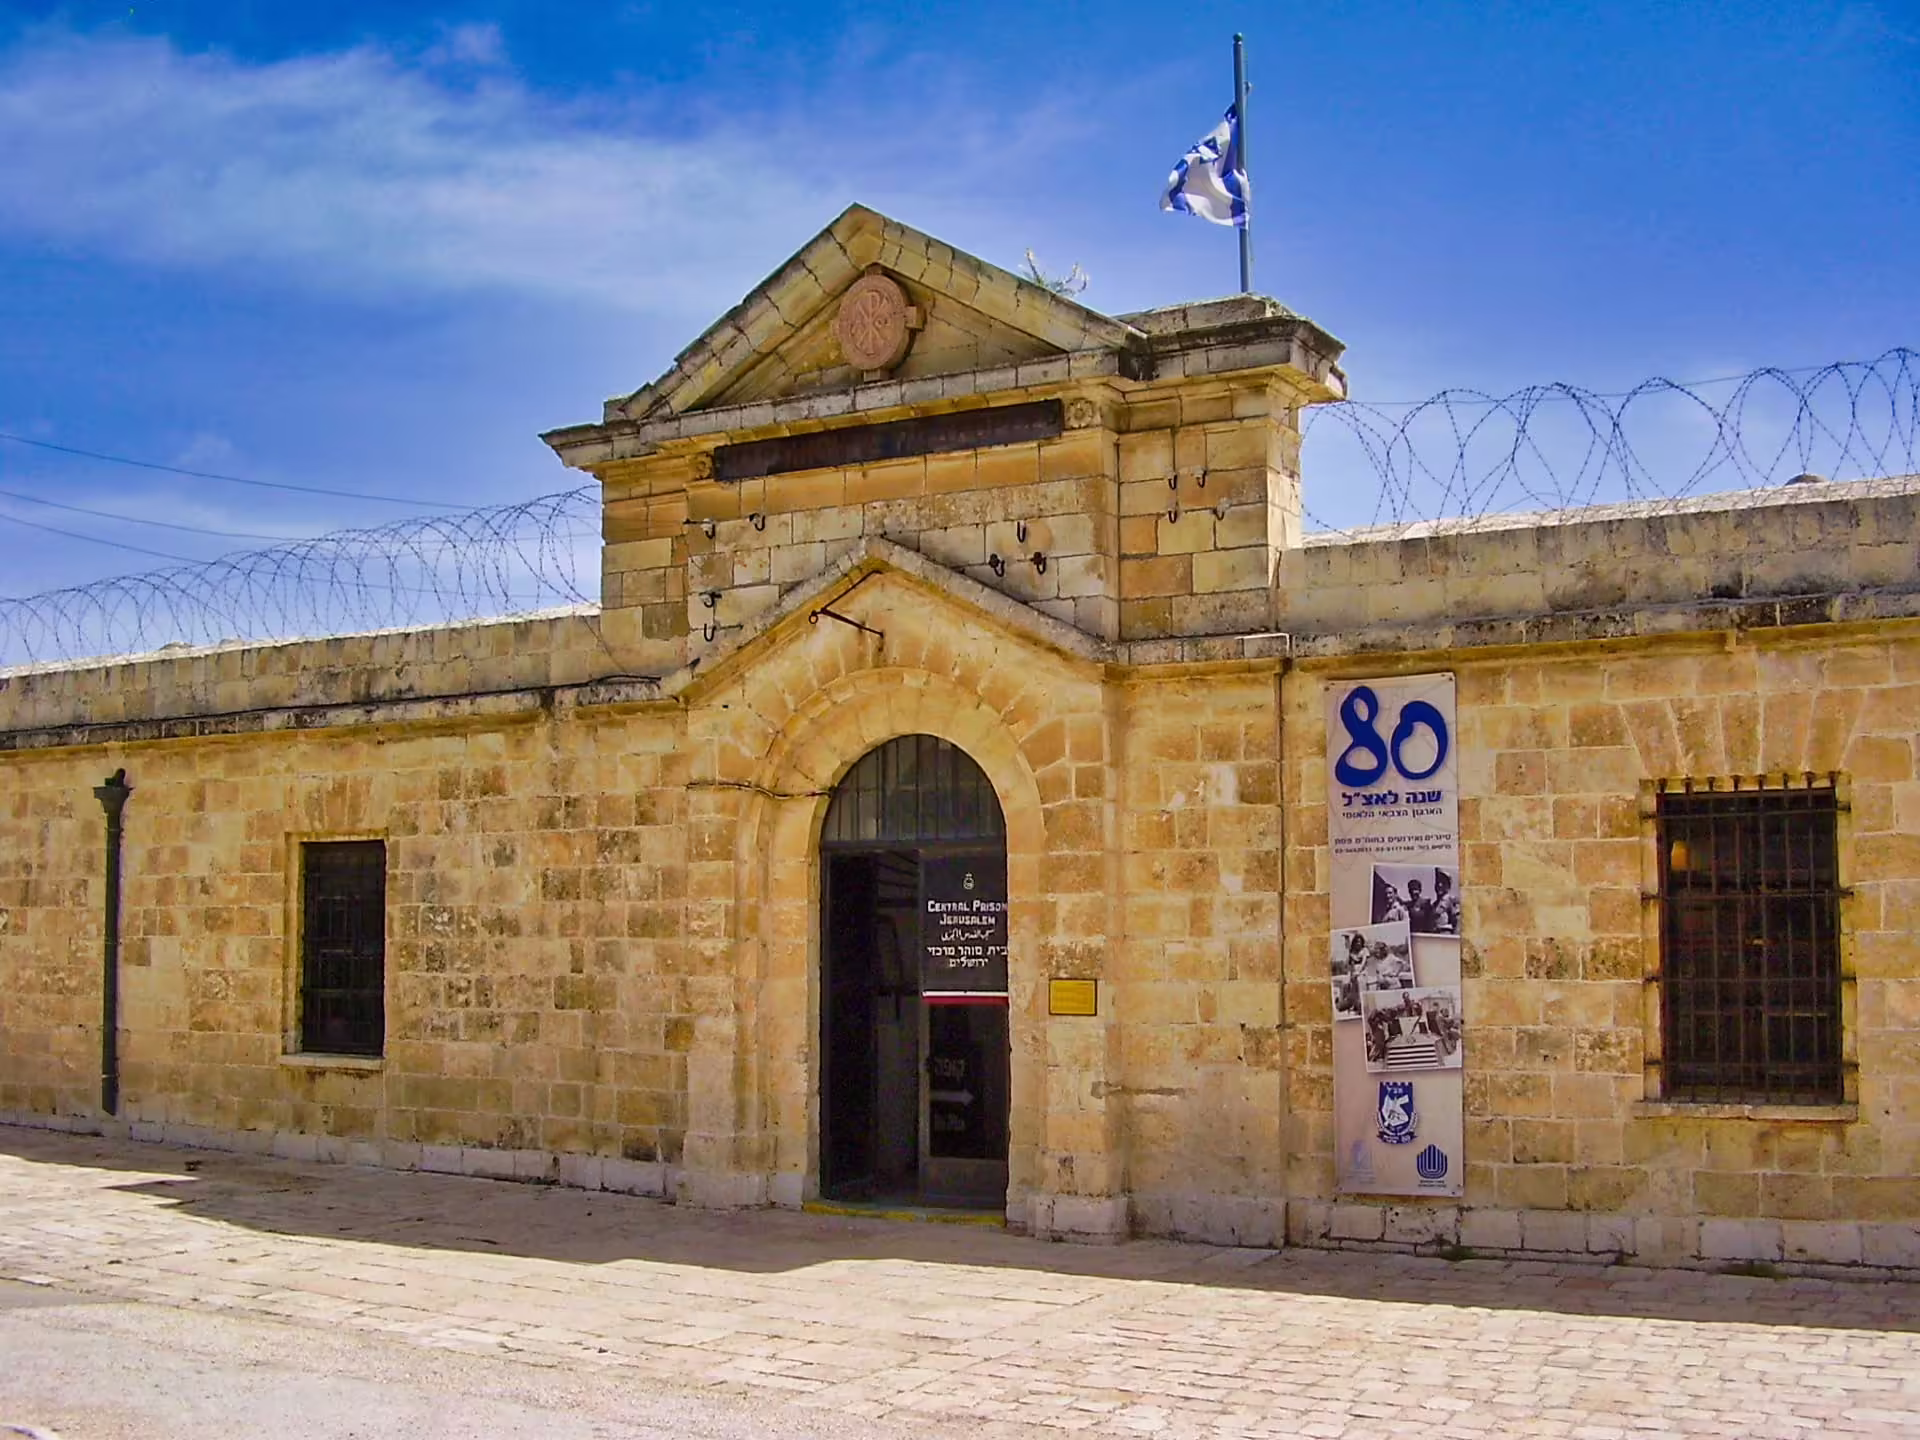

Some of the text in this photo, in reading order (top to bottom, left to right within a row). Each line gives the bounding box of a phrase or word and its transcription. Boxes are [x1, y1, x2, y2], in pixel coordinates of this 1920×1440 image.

[1334, 685, 1448, 788] 80
[1341, 789, 1442, 807] שנה לאצ"ל
[1342, 807, 1442, 819] הארגון הצבאי הלאומי
[927, 945, 1008, 956] בית סוהר מרכזי
[949, 956, 988, 967] ירושלים
